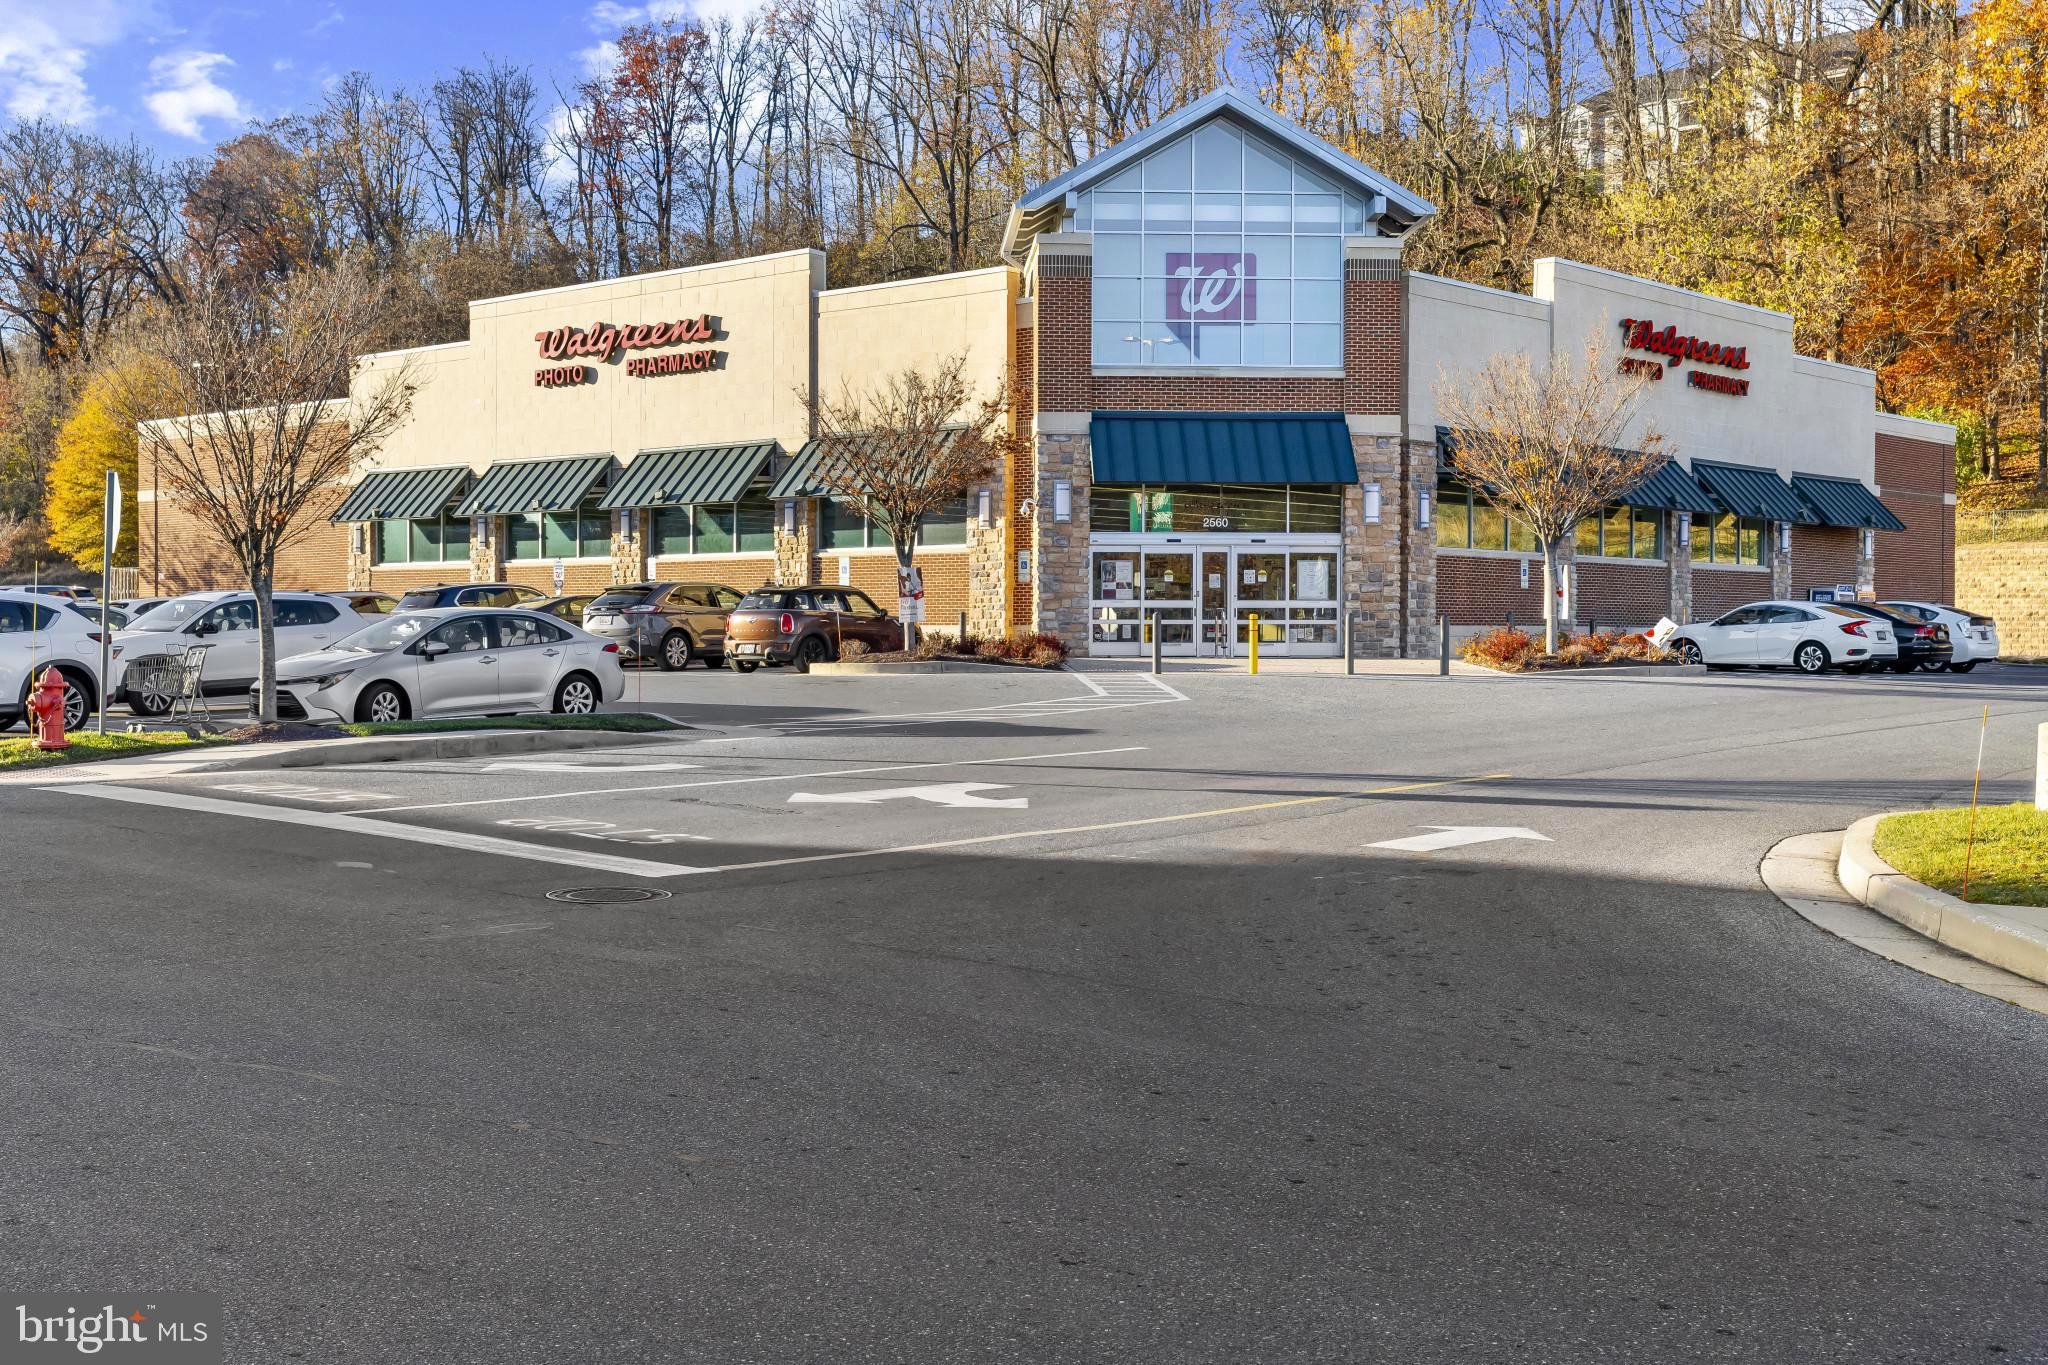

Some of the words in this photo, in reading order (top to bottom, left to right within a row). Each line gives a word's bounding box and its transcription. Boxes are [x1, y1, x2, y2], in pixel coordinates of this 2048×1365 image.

[535, 314, 713, 363] Walgreens
[1620, 318, 1750, 369] Walgreens
[535, 365, 585, 387] PHOTO
[626, 350, 714, 377] PHARMACY
[1690, 371, 1750, 396] PHARMACY
[1203, 517, 1228, 528] 2560
